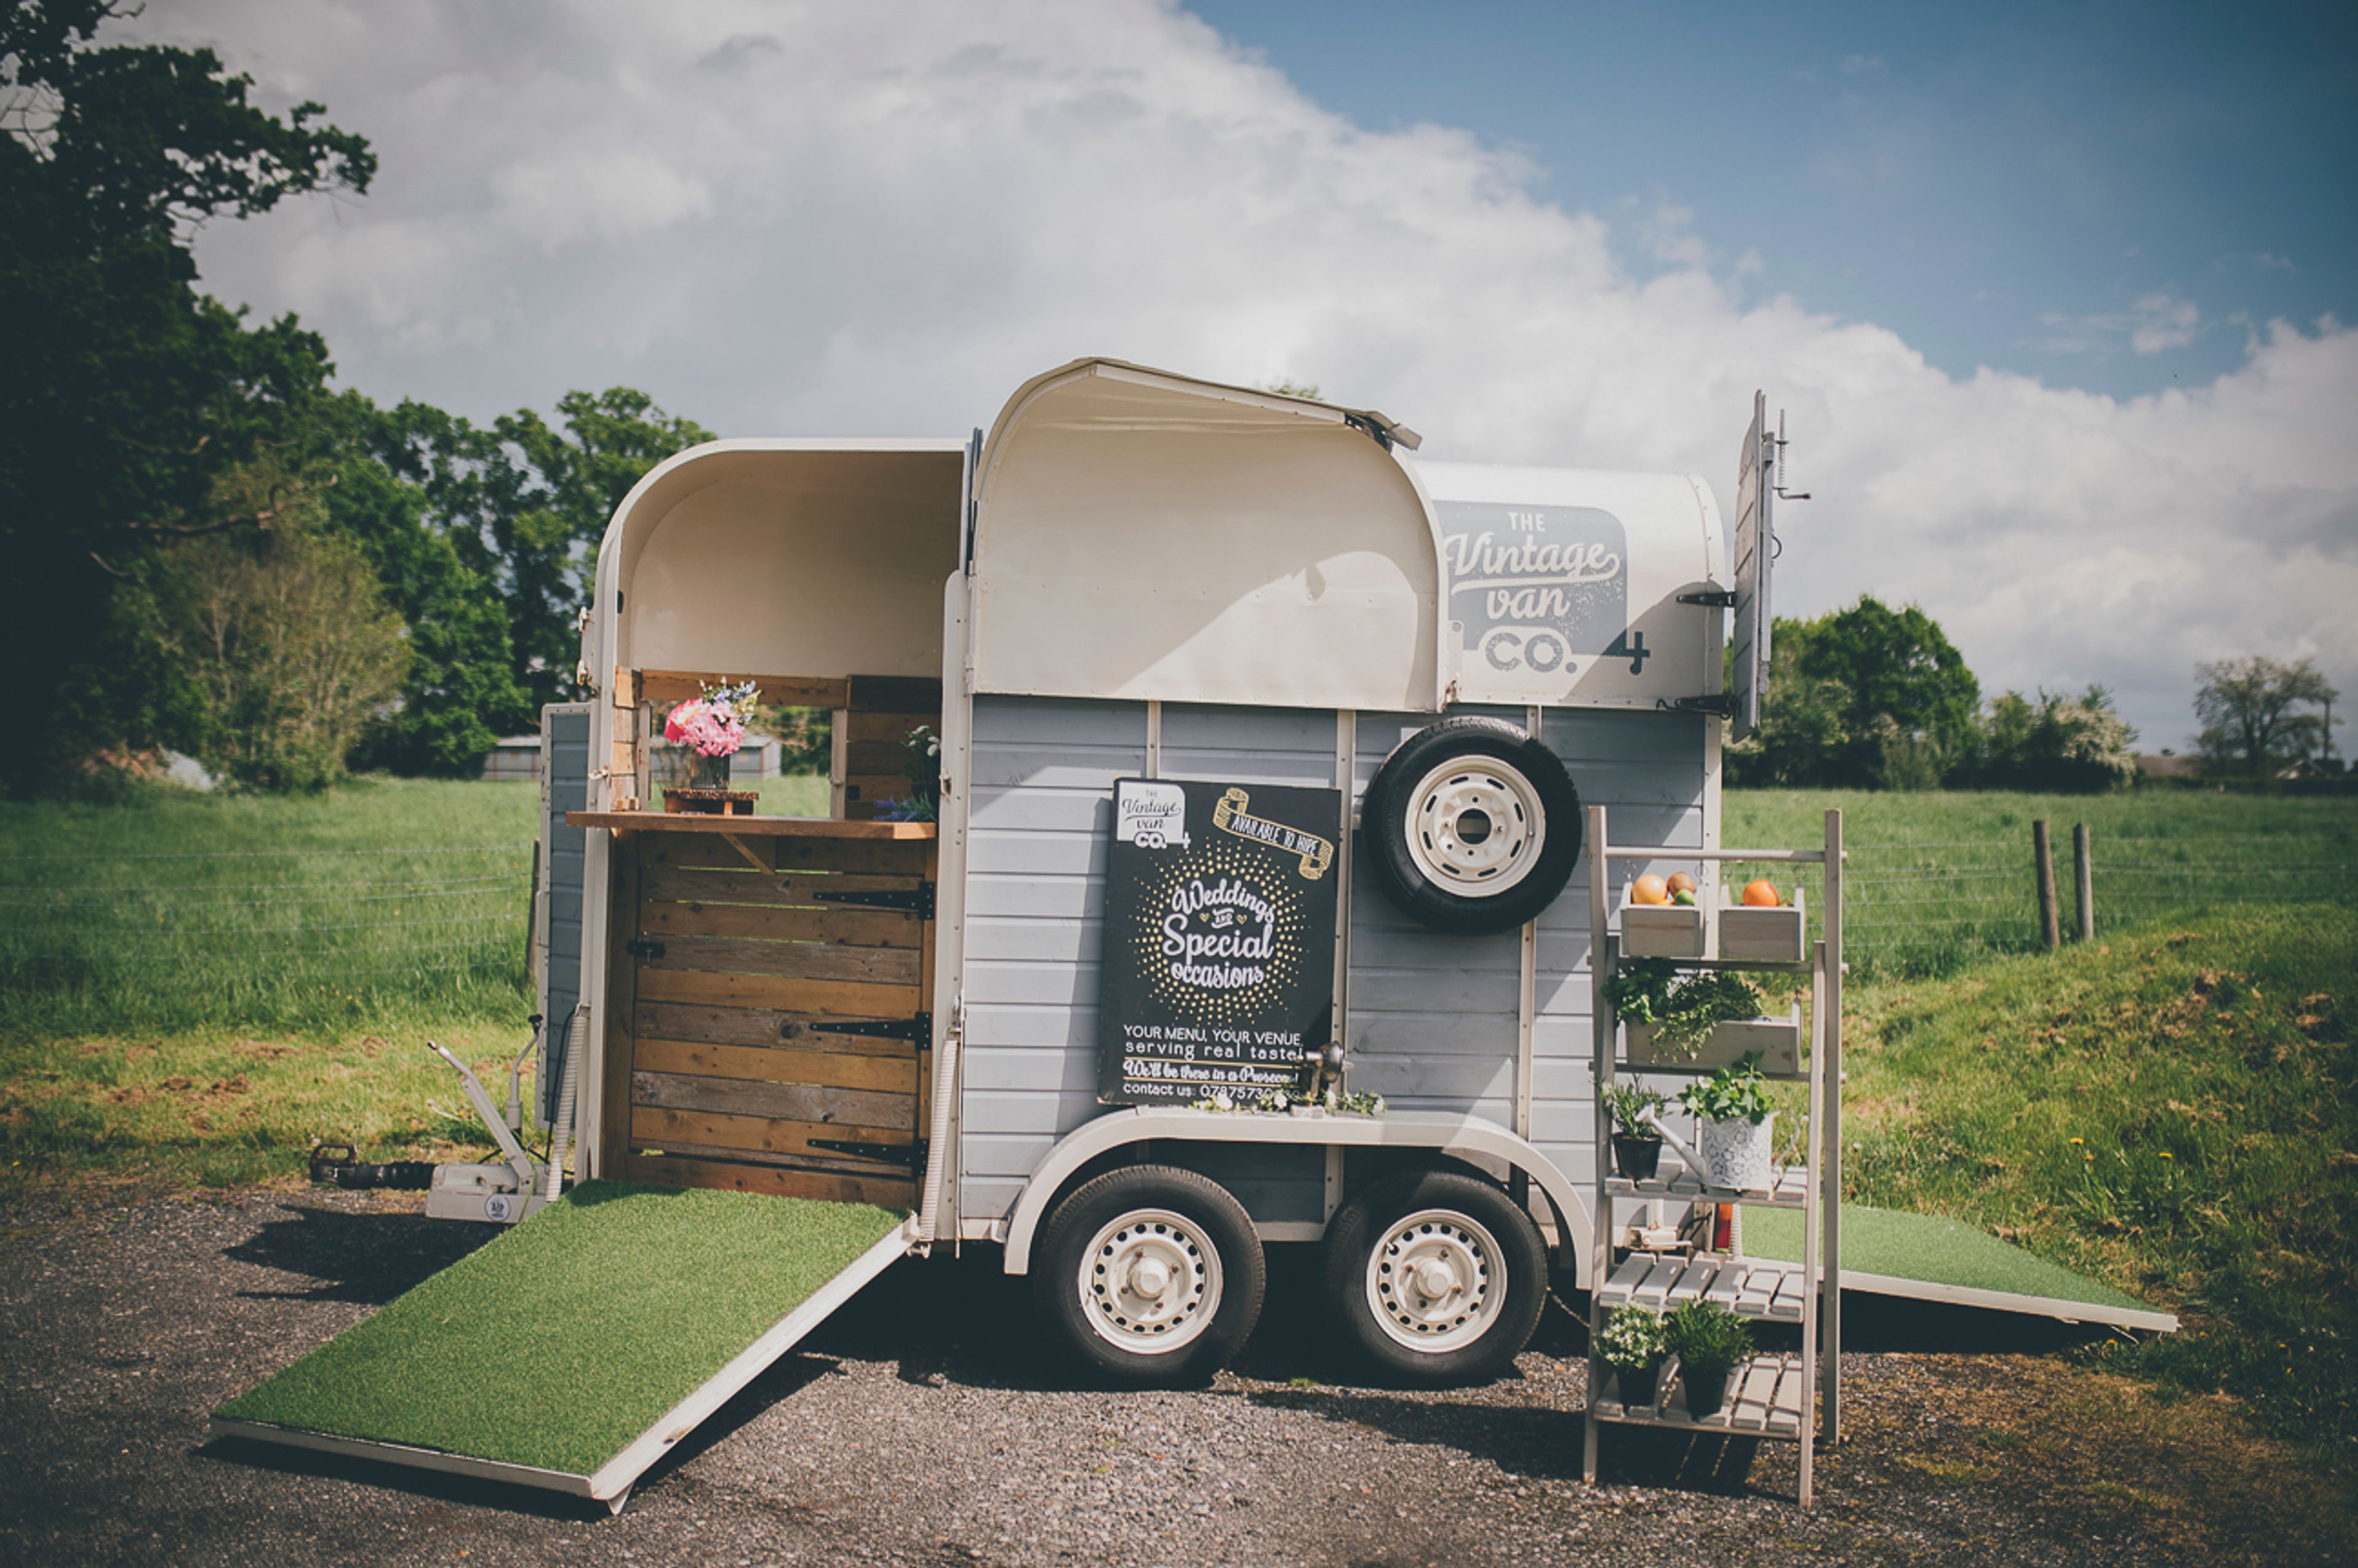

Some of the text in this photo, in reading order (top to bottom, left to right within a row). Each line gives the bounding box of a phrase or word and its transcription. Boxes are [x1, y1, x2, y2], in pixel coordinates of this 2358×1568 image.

[1508, 512, 1546, 532] THE
[1444, 531, 1621, 584] Vintage
[1486, 588, 1571, 620] van
[1485, 632, 1578, 674] CO.
[1122, 799, 1181, 817] Vintage
[1137, 819, 1164, 829] van
[1135, 831, 1167, 849] CO.
[1231, 815, 1320, 857] AVAILABLE TO HIRE
[1172, 878, 1275, 924] Weddings
[1162, 913, 1275, 966] Special
[1170, 960, 1264, 989] occasions
[1123, 1025, 1162, 1040] YOUR
[1212, 1029, 1250, 1044] YOUR
[1126, 1041, 1195, 1061] serving
[1204, 1042, 1240, 1058] real
[1163, 1063, 1178, 1078] be
[1180, 1065, 1210, 1080] there
[1212, 1068, 1226, 1081] in
[1228, 1071, 1238, 1082] a
[1123, 1082, 1173, 1096] contact
